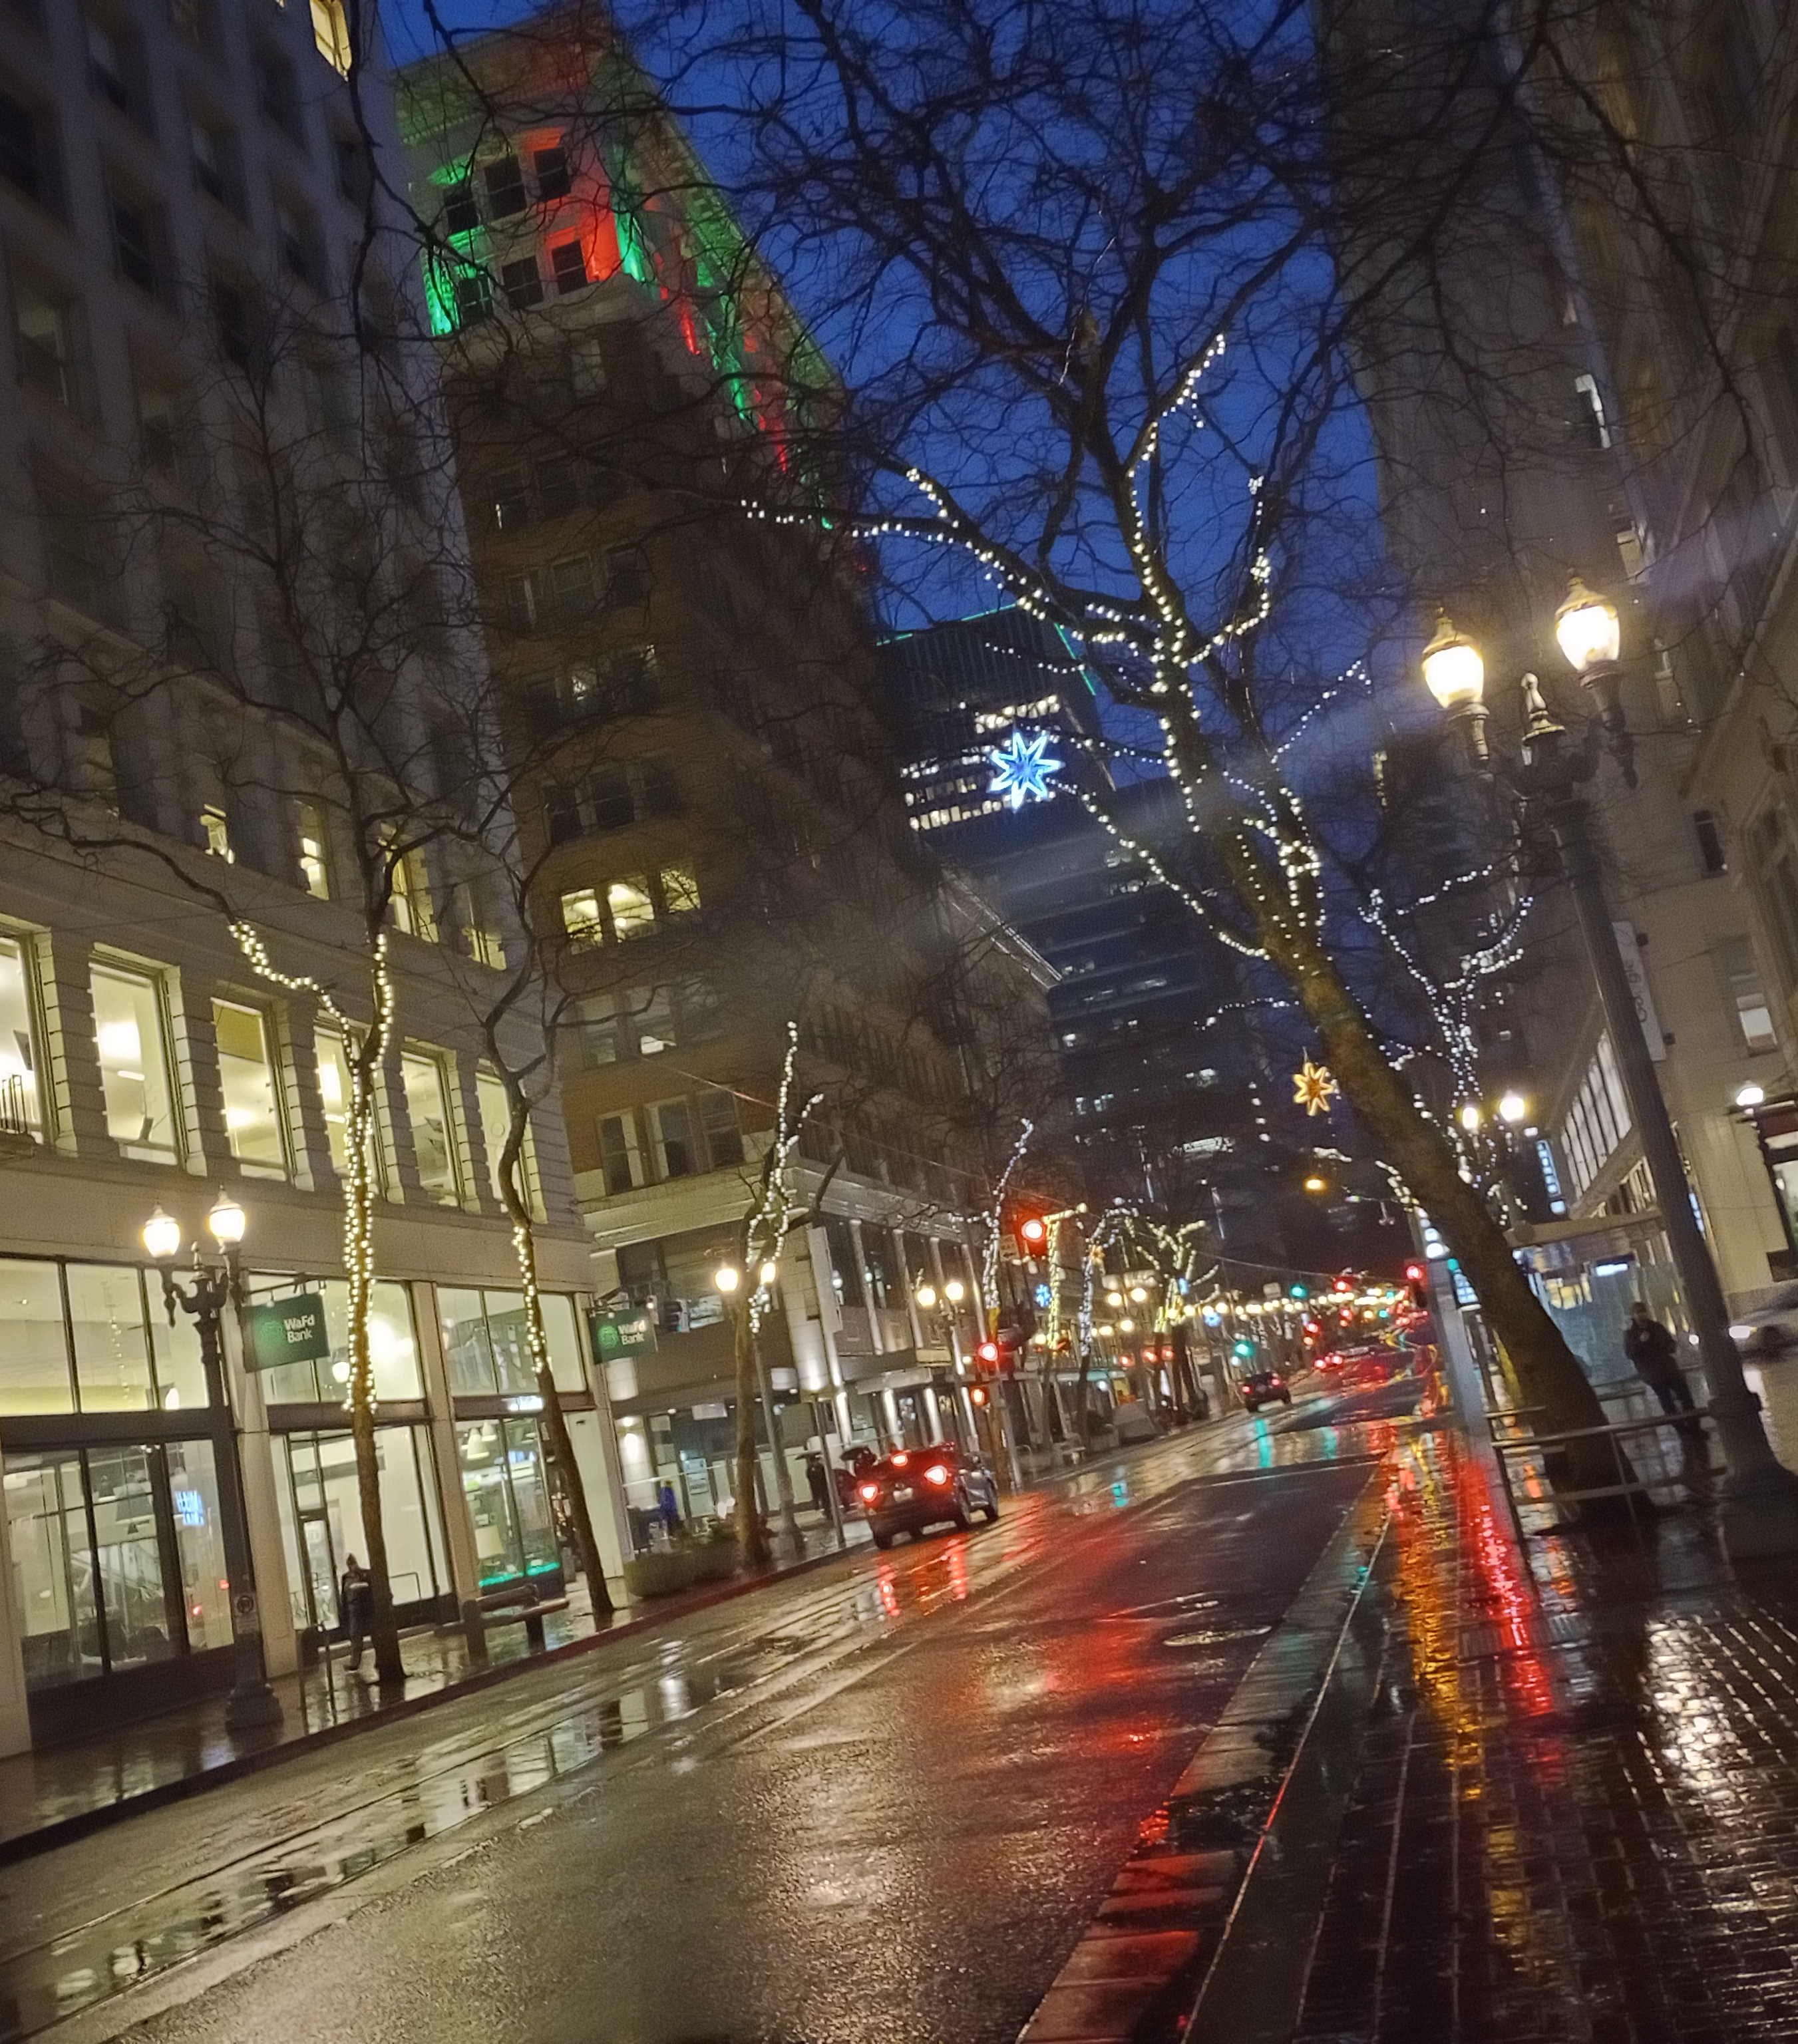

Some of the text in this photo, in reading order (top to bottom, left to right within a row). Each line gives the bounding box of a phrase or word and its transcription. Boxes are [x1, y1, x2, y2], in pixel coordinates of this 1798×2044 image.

[283, 1314, 315, 1331] WaFd
[287, 1328, 313, 1343] Bank
[622, 1332, 644, 1345] Bank
